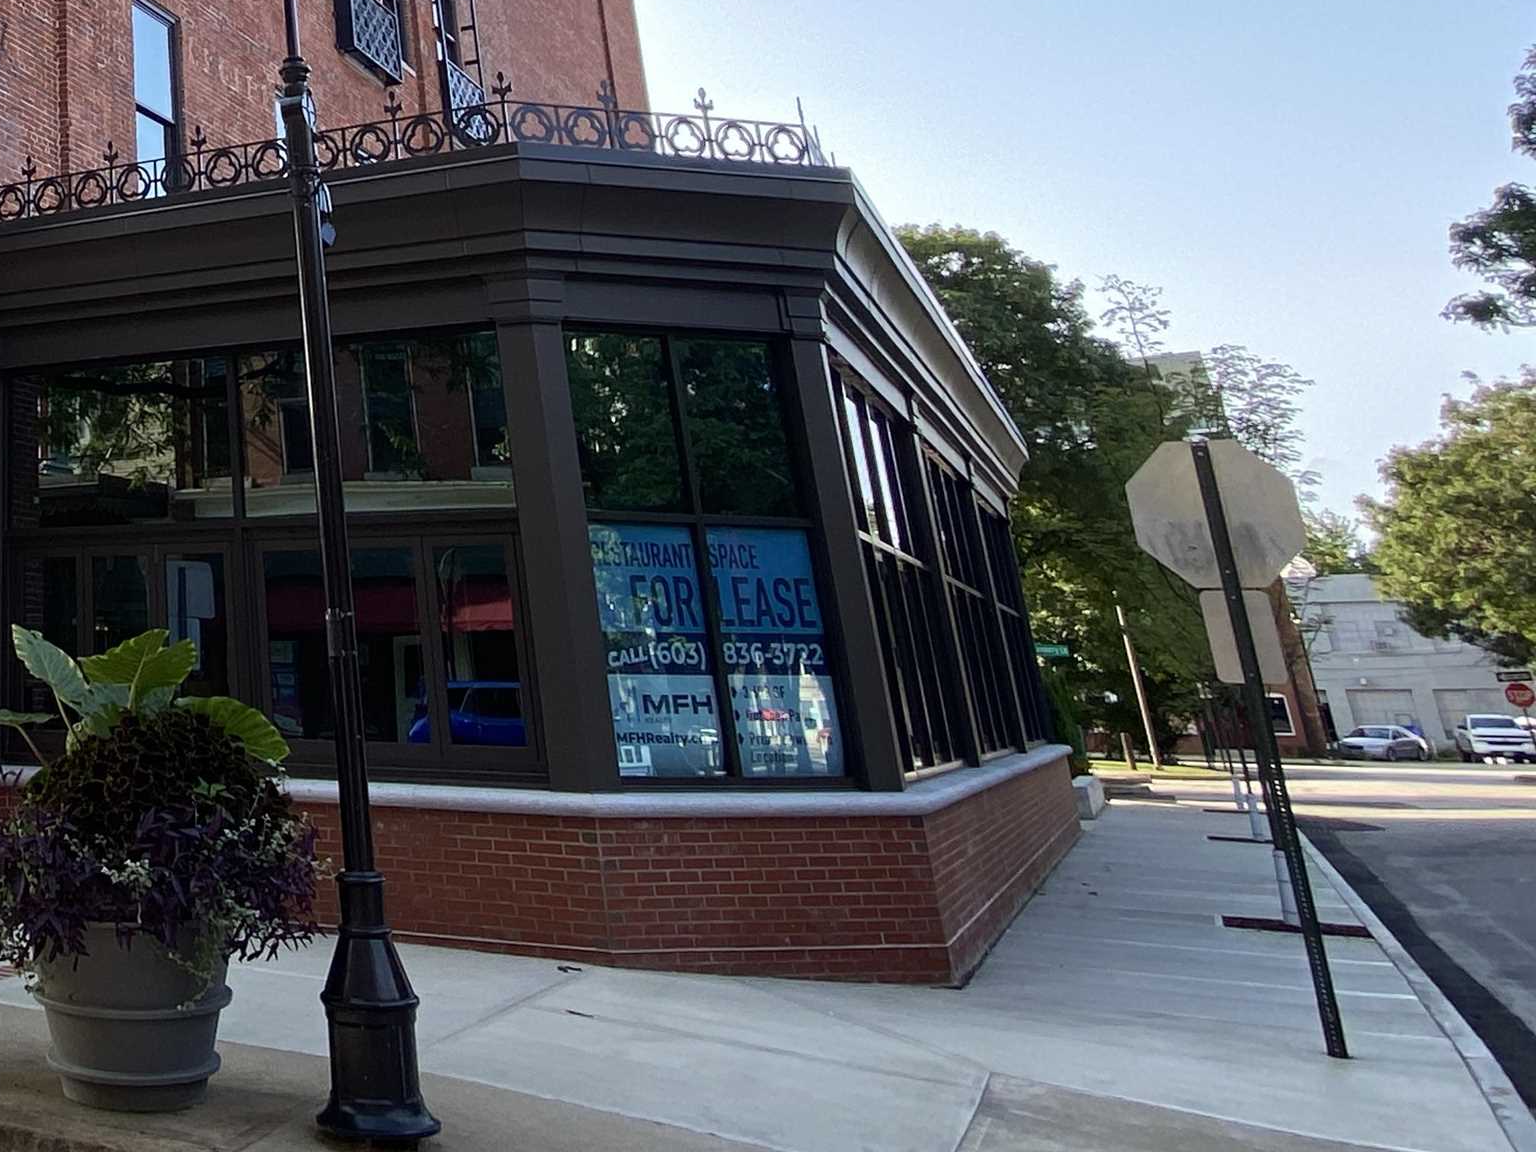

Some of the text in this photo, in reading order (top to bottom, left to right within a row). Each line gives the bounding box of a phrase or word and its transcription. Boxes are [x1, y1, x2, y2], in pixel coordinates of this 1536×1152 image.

[591, 542, 760, 570] RESTAURANT SPACE
[629, 575, 817, 628] FOR LEASE
[607, 640, 825, 670] CALL (603) 836-3722
[642, 694, 714, 715] MFH
[616, 732, 719, 746] MFHRealty.c
